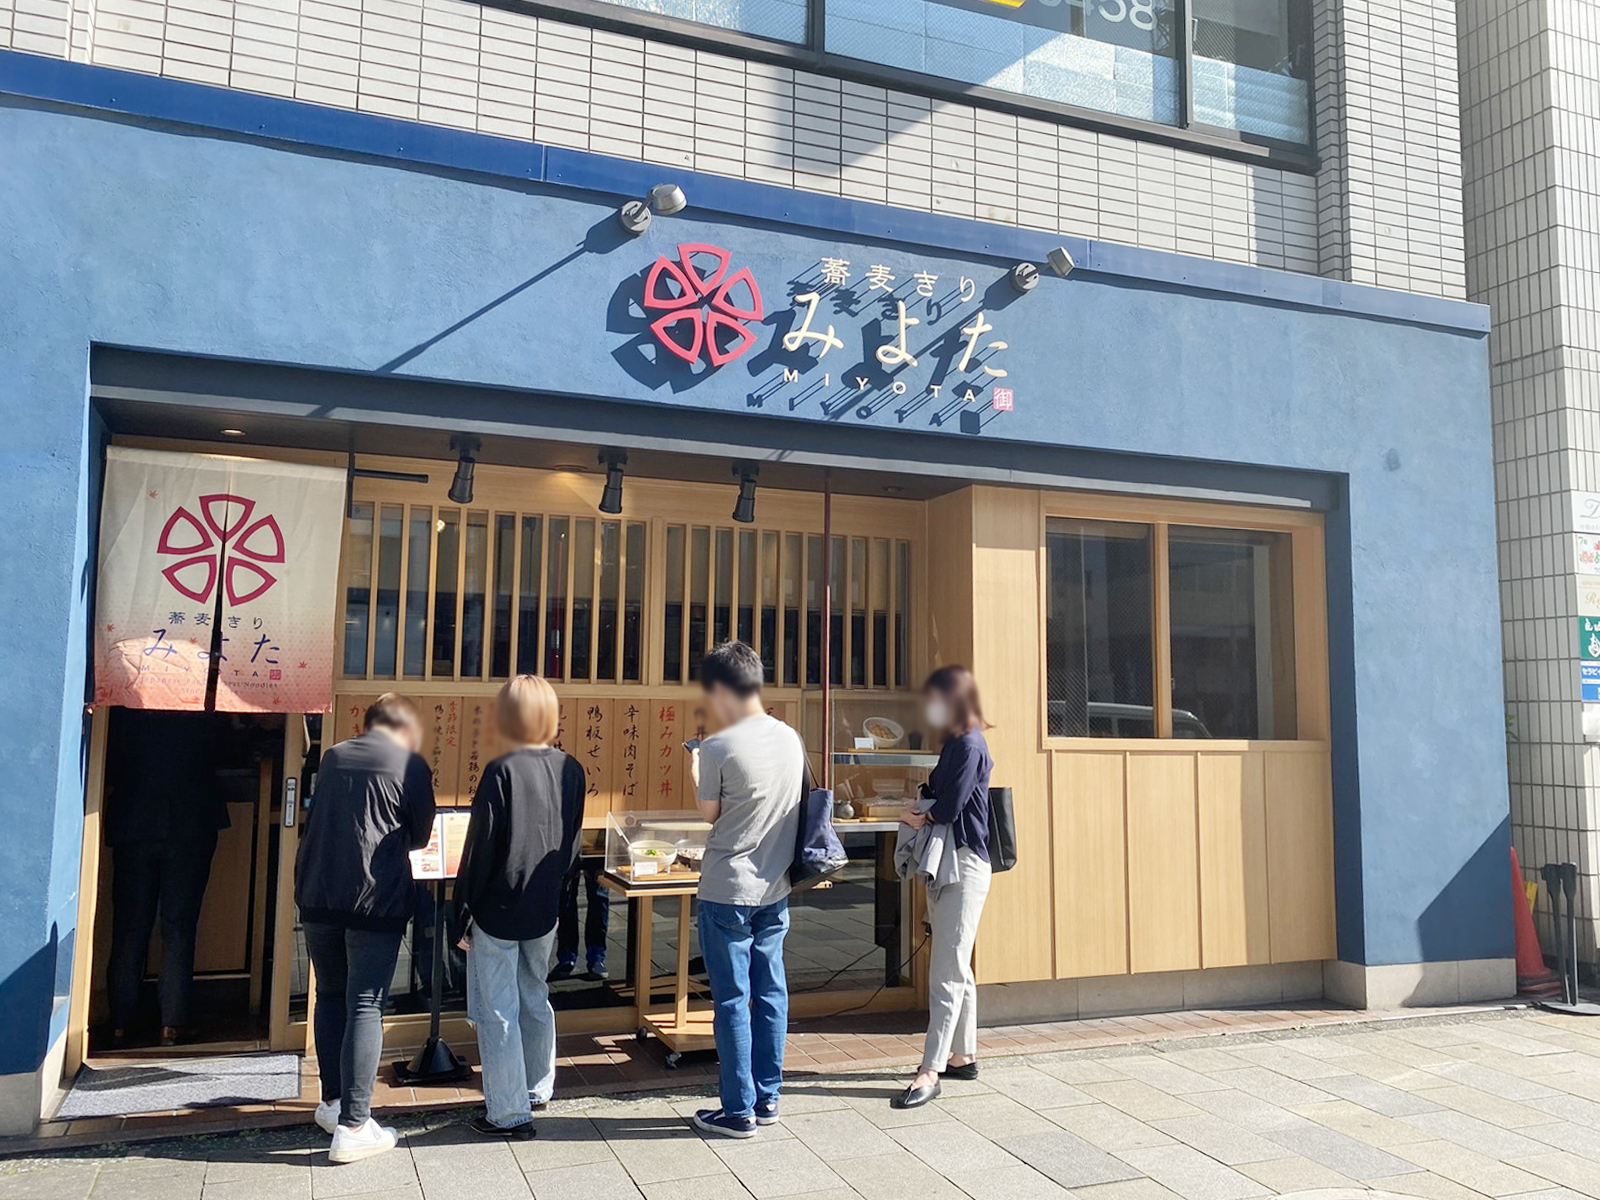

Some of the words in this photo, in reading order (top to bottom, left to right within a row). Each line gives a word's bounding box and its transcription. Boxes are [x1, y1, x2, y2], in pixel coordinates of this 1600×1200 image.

[820, 256, 976, 303] 蕎麦きり
[782, 291, 1009, 378] みよた
[783, 368, 977, 403] MIYOTA
[993, 387, 1014, 411] 御
[168, 611, 264, 630] 蕎麦きり
[143, 628, 280, 664] みよた
[244, 681, 278, 689] Noodles
[586, 704, 603, 798] 鴨板せいろ
[622, 704, 640, 797] 辛味肉そば
[659, 705, 676, 798] 極みカツ丼
